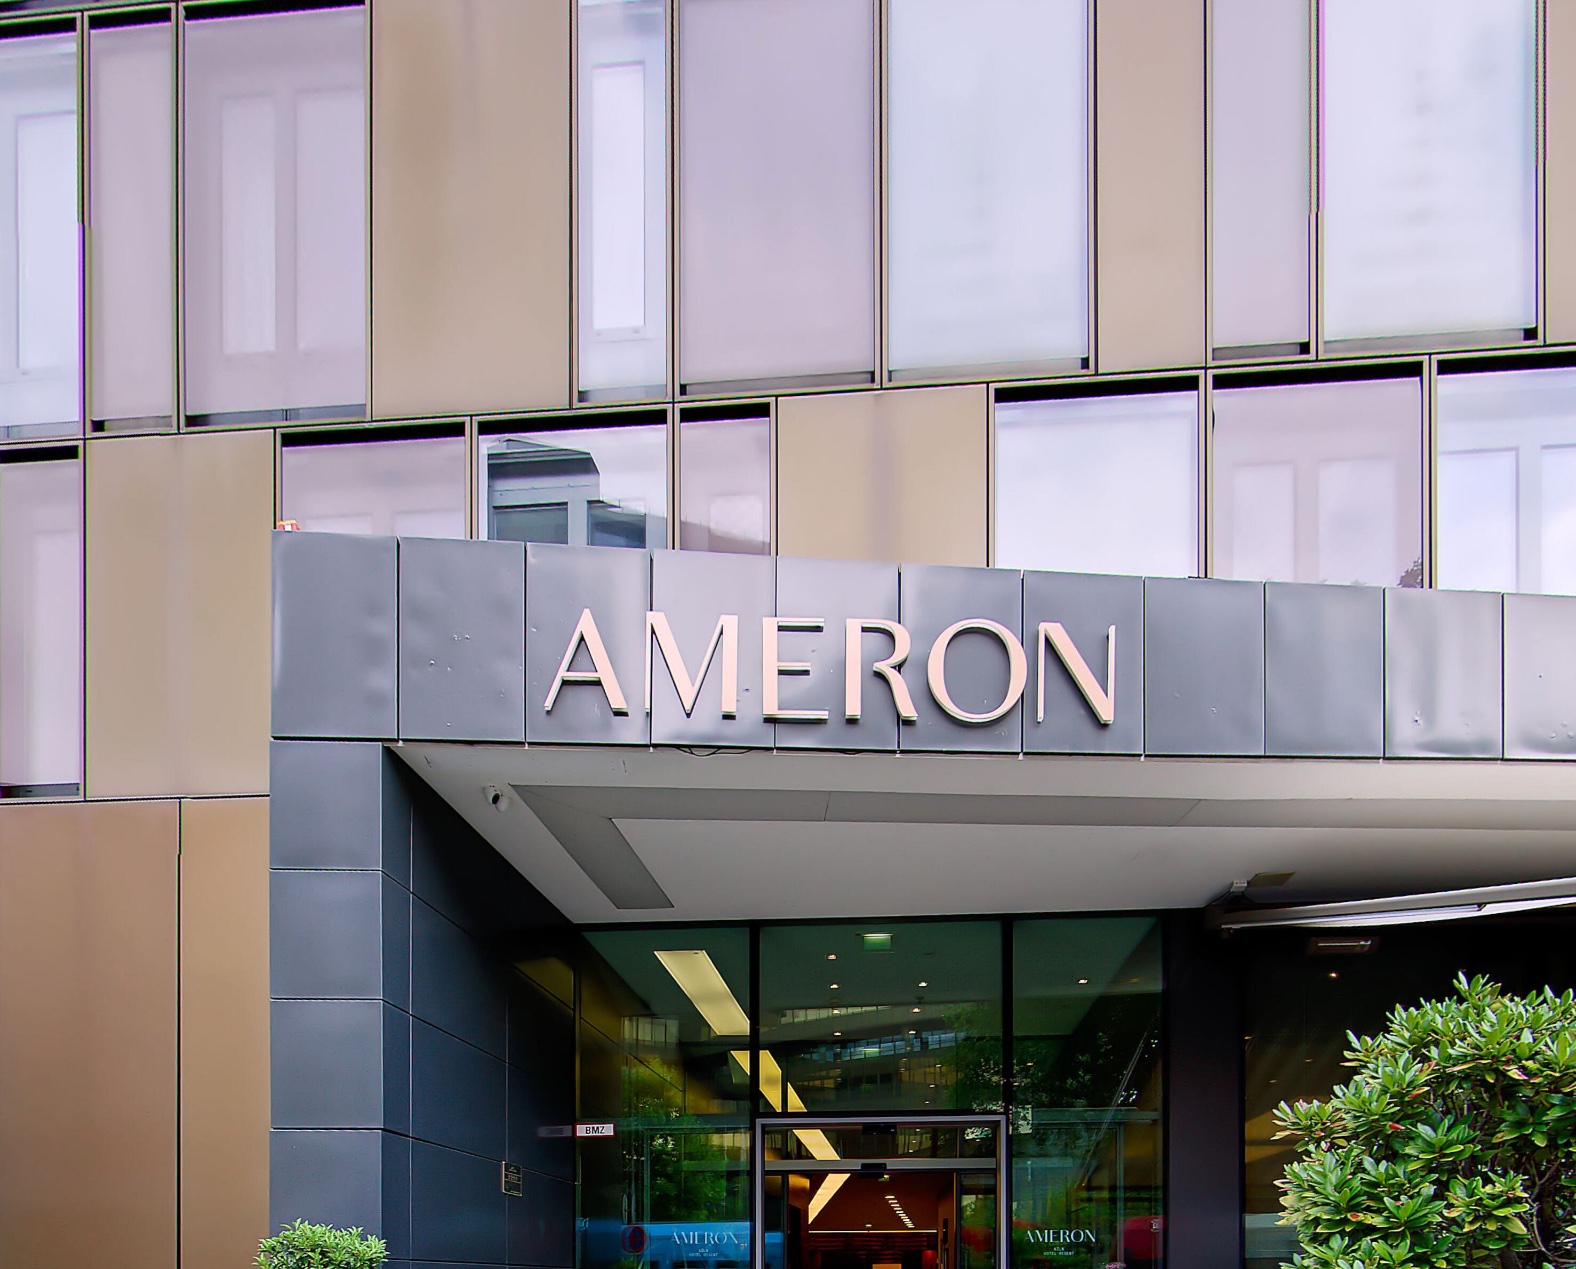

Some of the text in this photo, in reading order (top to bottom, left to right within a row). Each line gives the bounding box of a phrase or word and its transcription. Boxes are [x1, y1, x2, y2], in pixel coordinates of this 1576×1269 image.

[544, 608, 1116, 727] AMERON
[585, 1126, 605, 1135] BMZ
[671, 1231, 739, 1245] AMERON
[1025, 1229, 1096, 1243] AMERON
